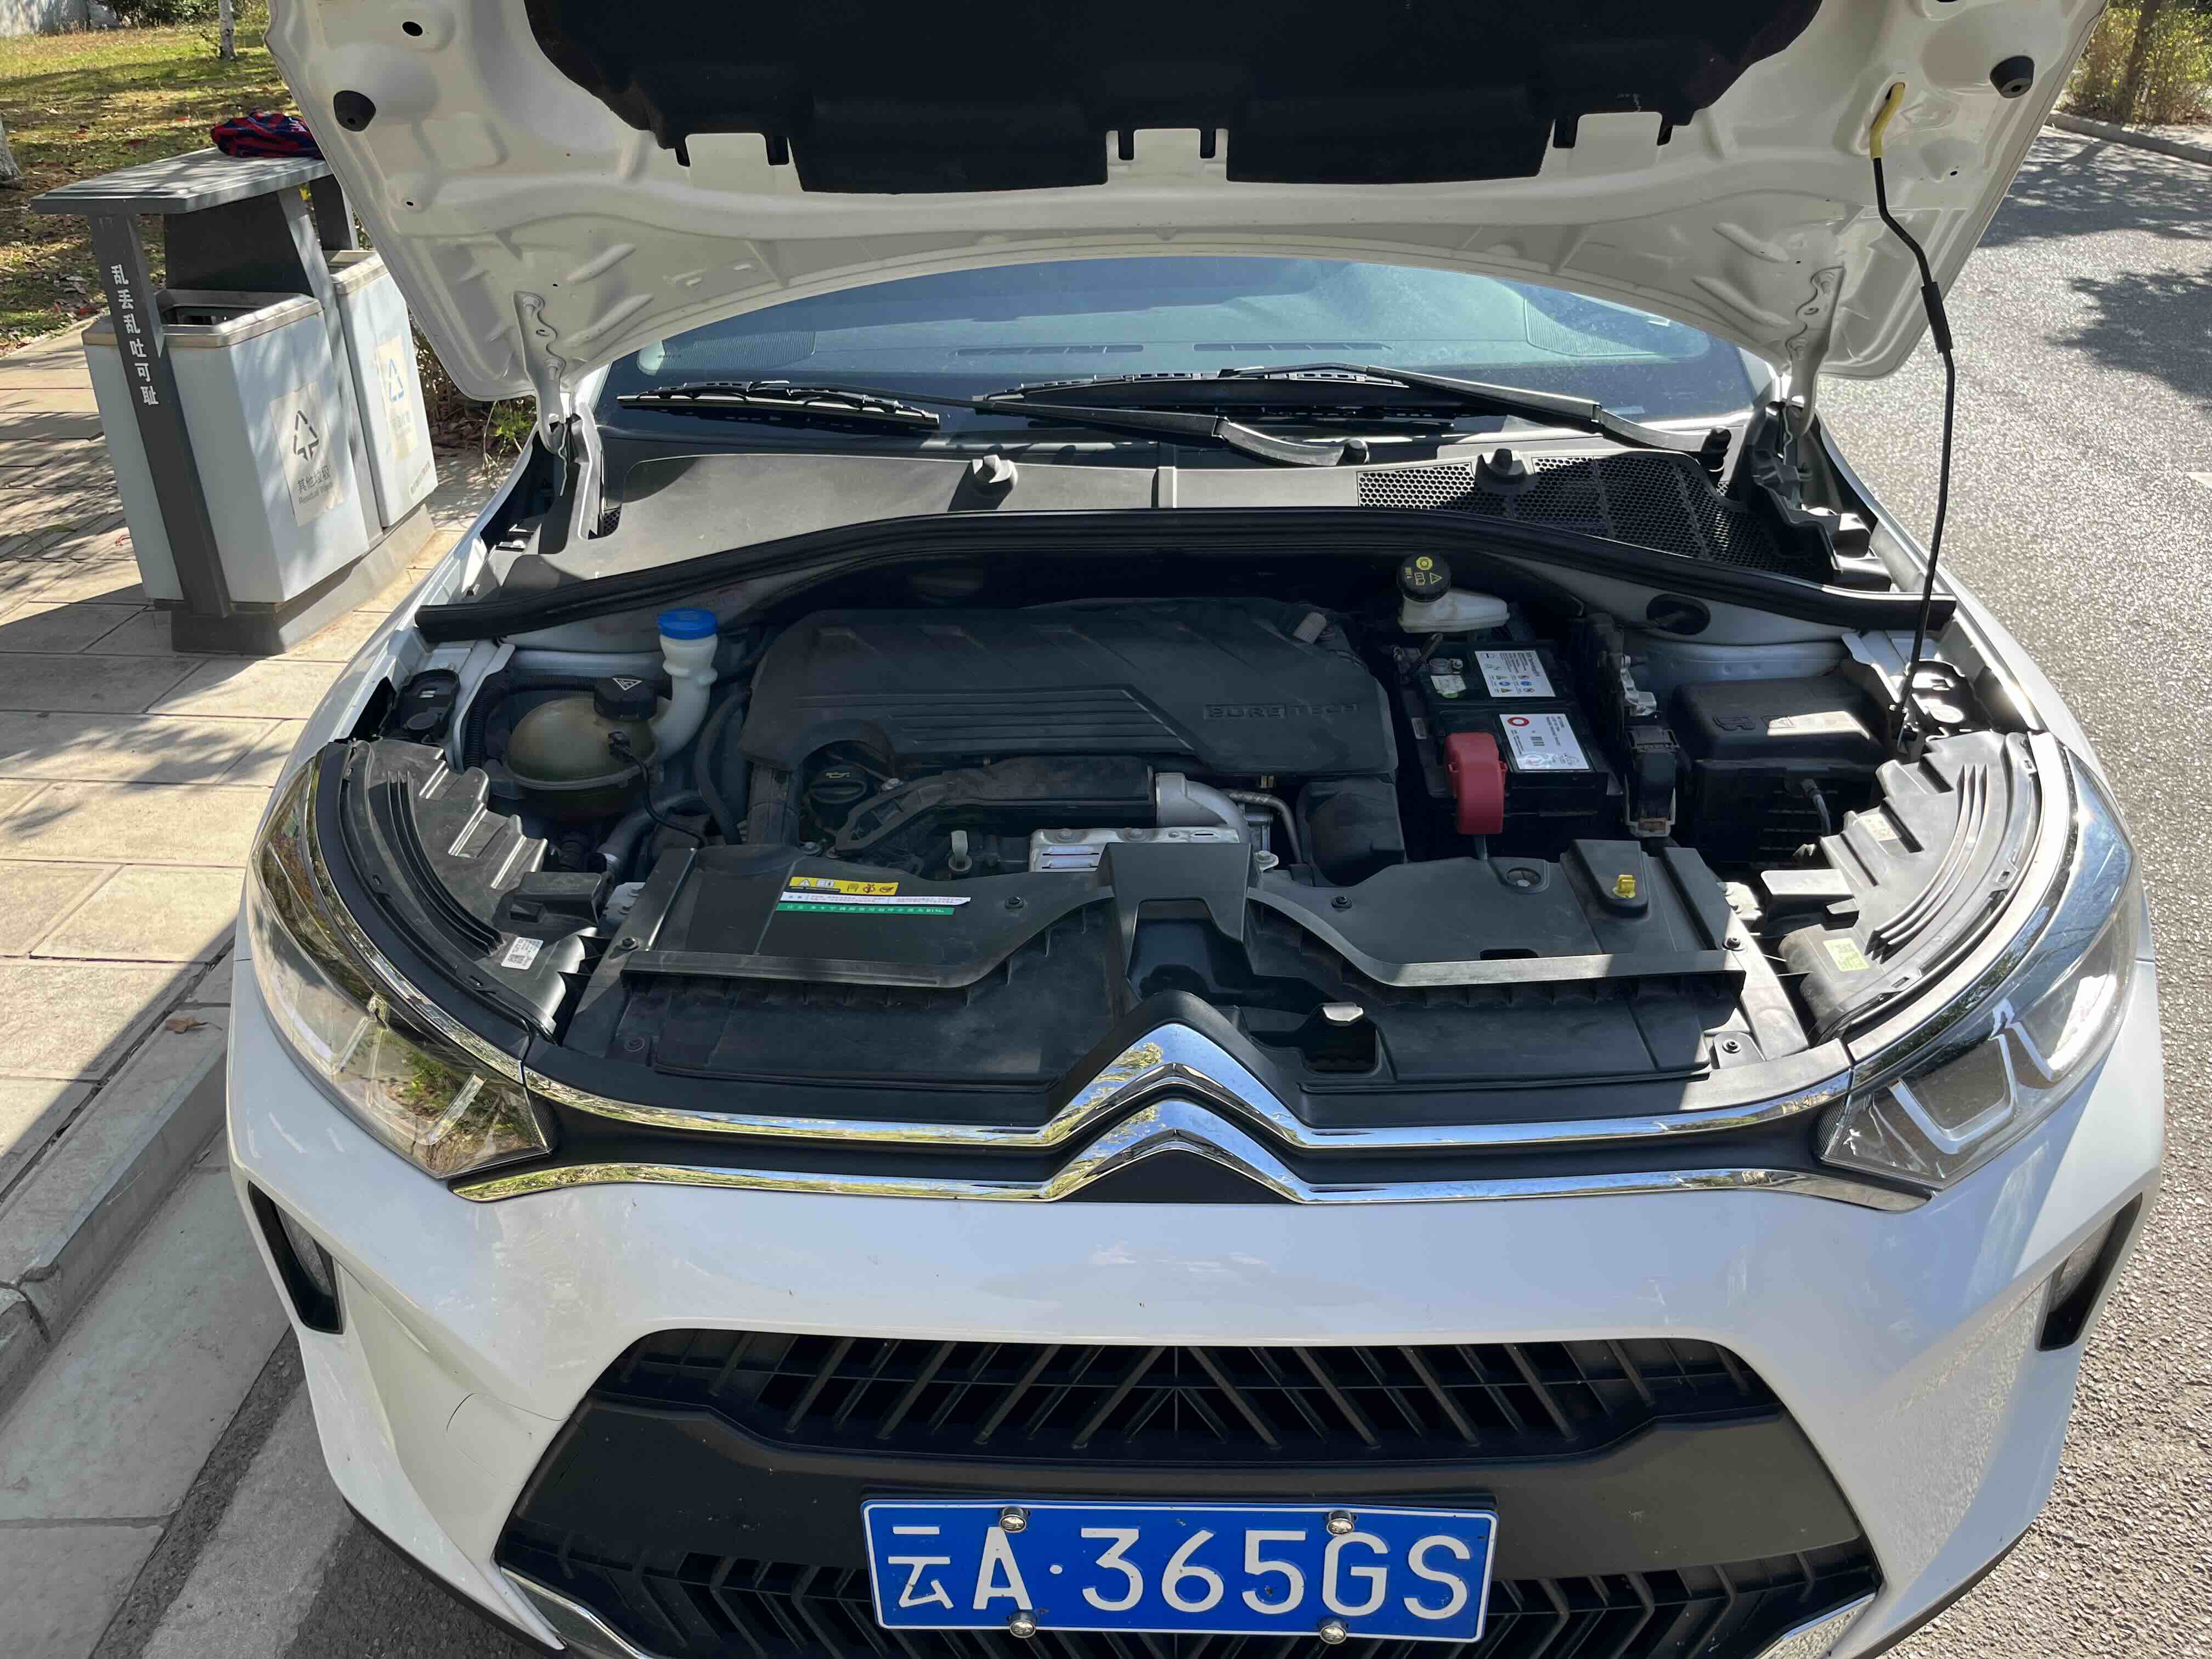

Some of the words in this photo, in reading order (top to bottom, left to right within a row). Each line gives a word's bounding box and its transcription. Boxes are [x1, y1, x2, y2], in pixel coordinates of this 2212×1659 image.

[110, 264, 159, 405] 乱丢乱吐可耻
